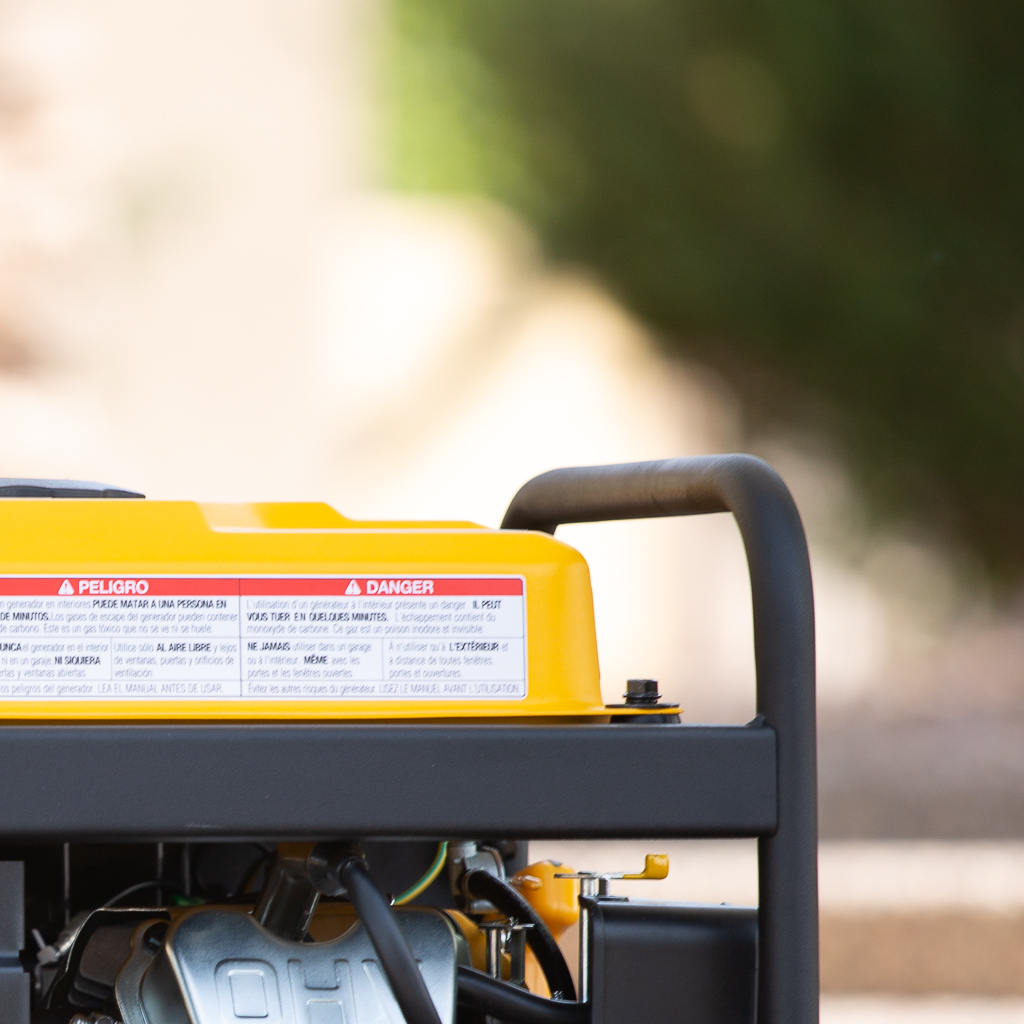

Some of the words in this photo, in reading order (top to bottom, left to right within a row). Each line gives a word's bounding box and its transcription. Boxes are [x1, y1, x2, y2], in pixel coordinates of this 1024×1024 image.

[79, 580, 149, 594] PELIGRO
[367, 580, 434, 594] DANGER
[92, 599, 117, 609] PUEDE
[120, 599, 148, 609] MATAR
[158, 599, 174, 609] UNA
[177, 599, 214, 609] PERSONA
[216, 599, 226, 609] EN
[0, 612, 10, 621] DE
[247, 612, 268, 621] VOUS
[270, 612, 289, 621] TUER
[294, 612, 306, 621] EN
[309, 612, 349, 621] QUELQUES
